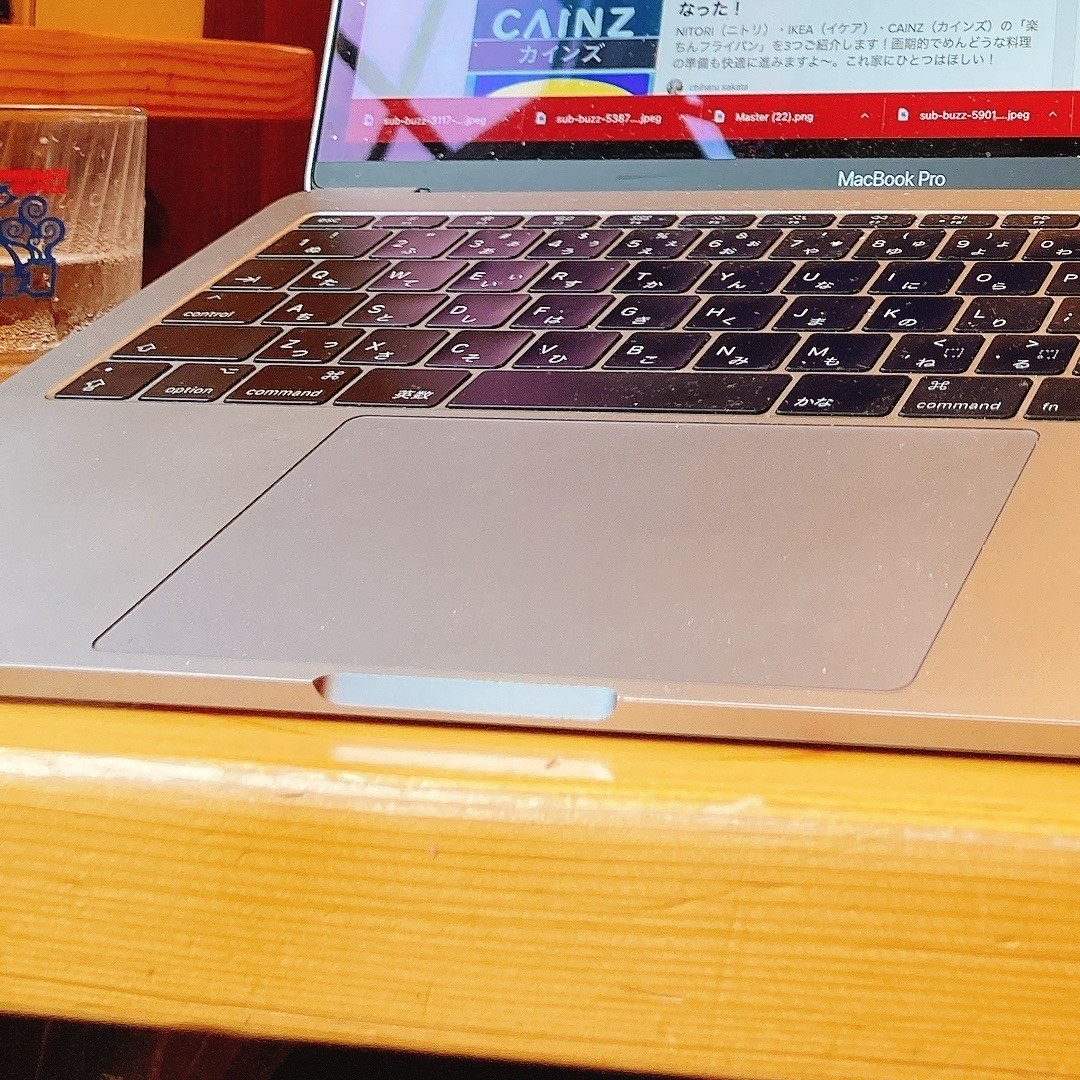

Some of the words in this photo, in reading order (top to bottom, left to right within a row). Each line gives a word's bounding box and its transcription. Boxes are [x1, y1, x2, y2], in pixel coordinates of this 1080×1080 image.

[679, 1, 742, 18] なった！
[492, 6, 636, 41] CAINZ
[675, 36, 1032, 54] ちんフライパン」を3つご紹介します！画期的でめんどうな料理
[519, 42, 606, 64] カインズ
[689, 82, 719, 92] chiharu
[721, 81, 749, 91] sakata
[735, 111, 771, 122] Master
[772, 110, 814, 124] (22).png
[838, 171, 915, 187] MacBook
[919, 171, 946, 186] Pro
[469, 240, 484, 248] 3
[957, 240, 970, 248] 9
[312, 271, 329, 279] Q
[390, 271, 411, 279] W
[470, 272, 486, 280] E
[551, 272, 568, 280] R
[638, 272, 651, 280] T
[721, 273, 734, 281] Y
[803, 273, 820, 281] U
[977, 274, 992, 282] O
[1064, 274, 1078, 282] P
[287, 304, 303, 312] A
[368, 305, 385, 313] S
[450, 306, 467, 314] D
[533, 307, 550, 315] F
[621, 307, 638, 316] G
[706, 308, 725, 316] H
[794, 309, 808, 317] J
[884, 309, 900, 318] K
[974, 310, 985, 318] L
[280, 339, 300, 348] Z
[365, 342, 385, 351] X
[451, 344, 469, 353] C
[542, 345, 558, 354] V
[627, 346, 644, 354] B
[717, 346, 736, 355] N
[808, 347, 829, 356] M
[165, 386, 213, 394] option
[794, 397, 833, 407] かな
[917, 402, 1001, 411] command
[1043, 402, 1058, 411] fn
